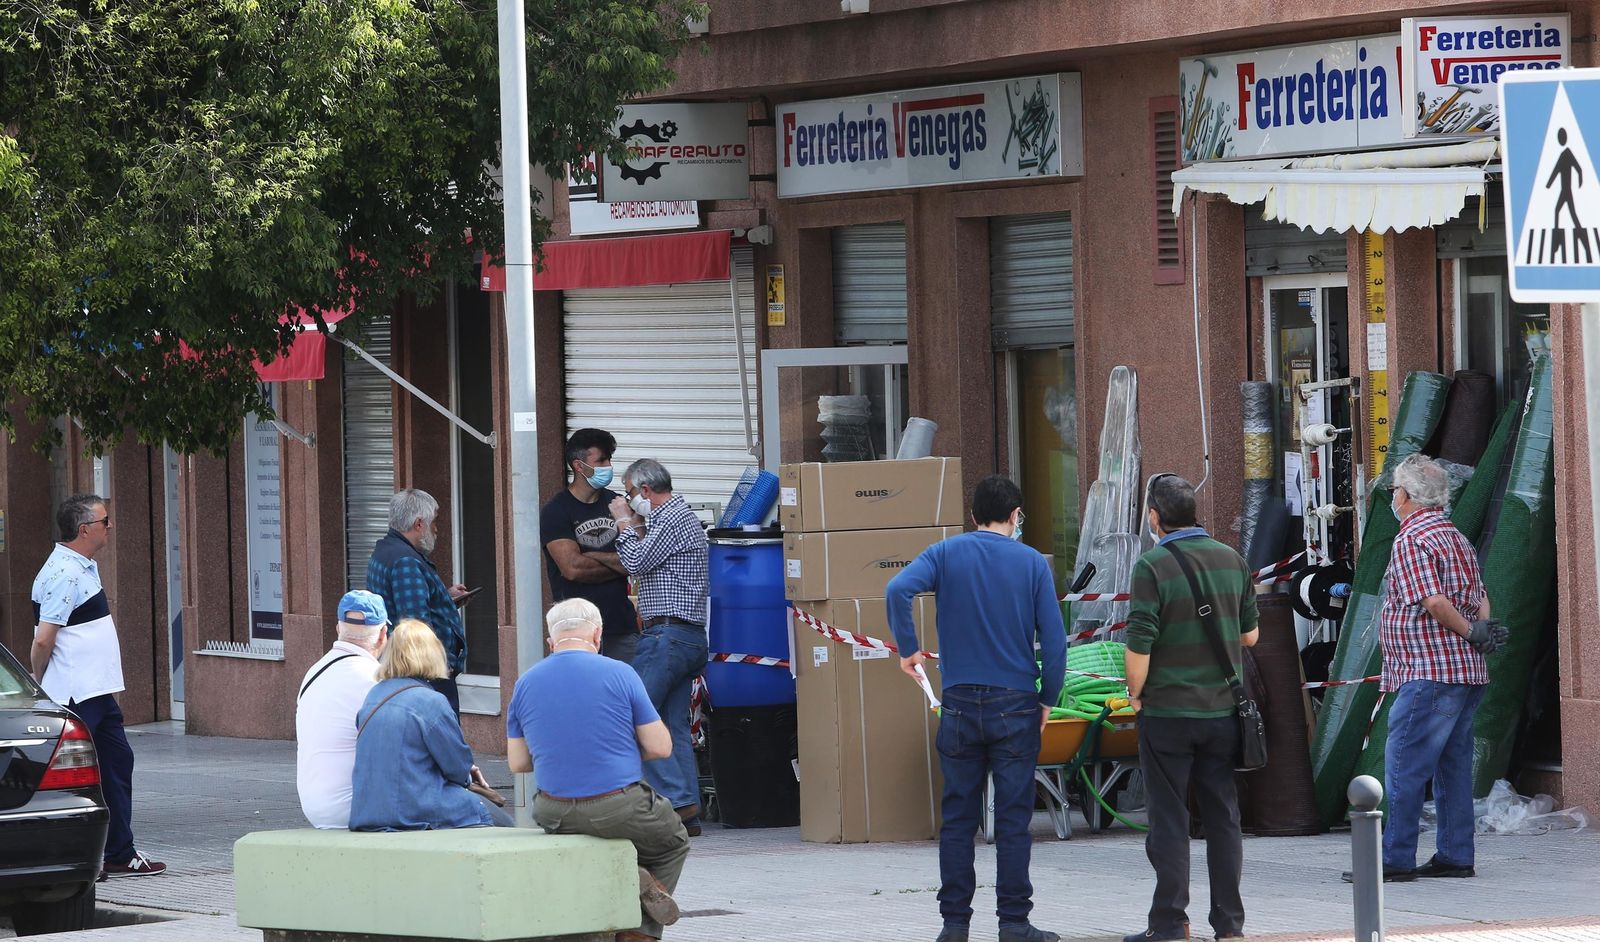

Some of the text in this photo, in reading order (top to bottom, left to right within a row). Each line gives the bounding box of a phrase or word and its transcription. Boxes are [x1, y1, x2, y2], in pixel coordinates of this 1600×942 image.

[1419, 22, 1561, 51] Ferreteria
[1236, 46, 1389, 131] Ferreteria
[782, 99, 987, 171] Ferreteria Venegas
[610, 200, 695, 220] RECAMBIOS DEL AUTOMOVIL
[1373, 250, 1383, 258] 2
[1374, 278, 1384, 286] 3
[1375, 306, 1384, 314] 4
[1377, 389, 1387, 397] 7
[1378, 417, 1388, 425] 8
[855, 489, 889, 498] sime
[27, 725, 50, 733] CDI
[128, 857, 143, 870] N
